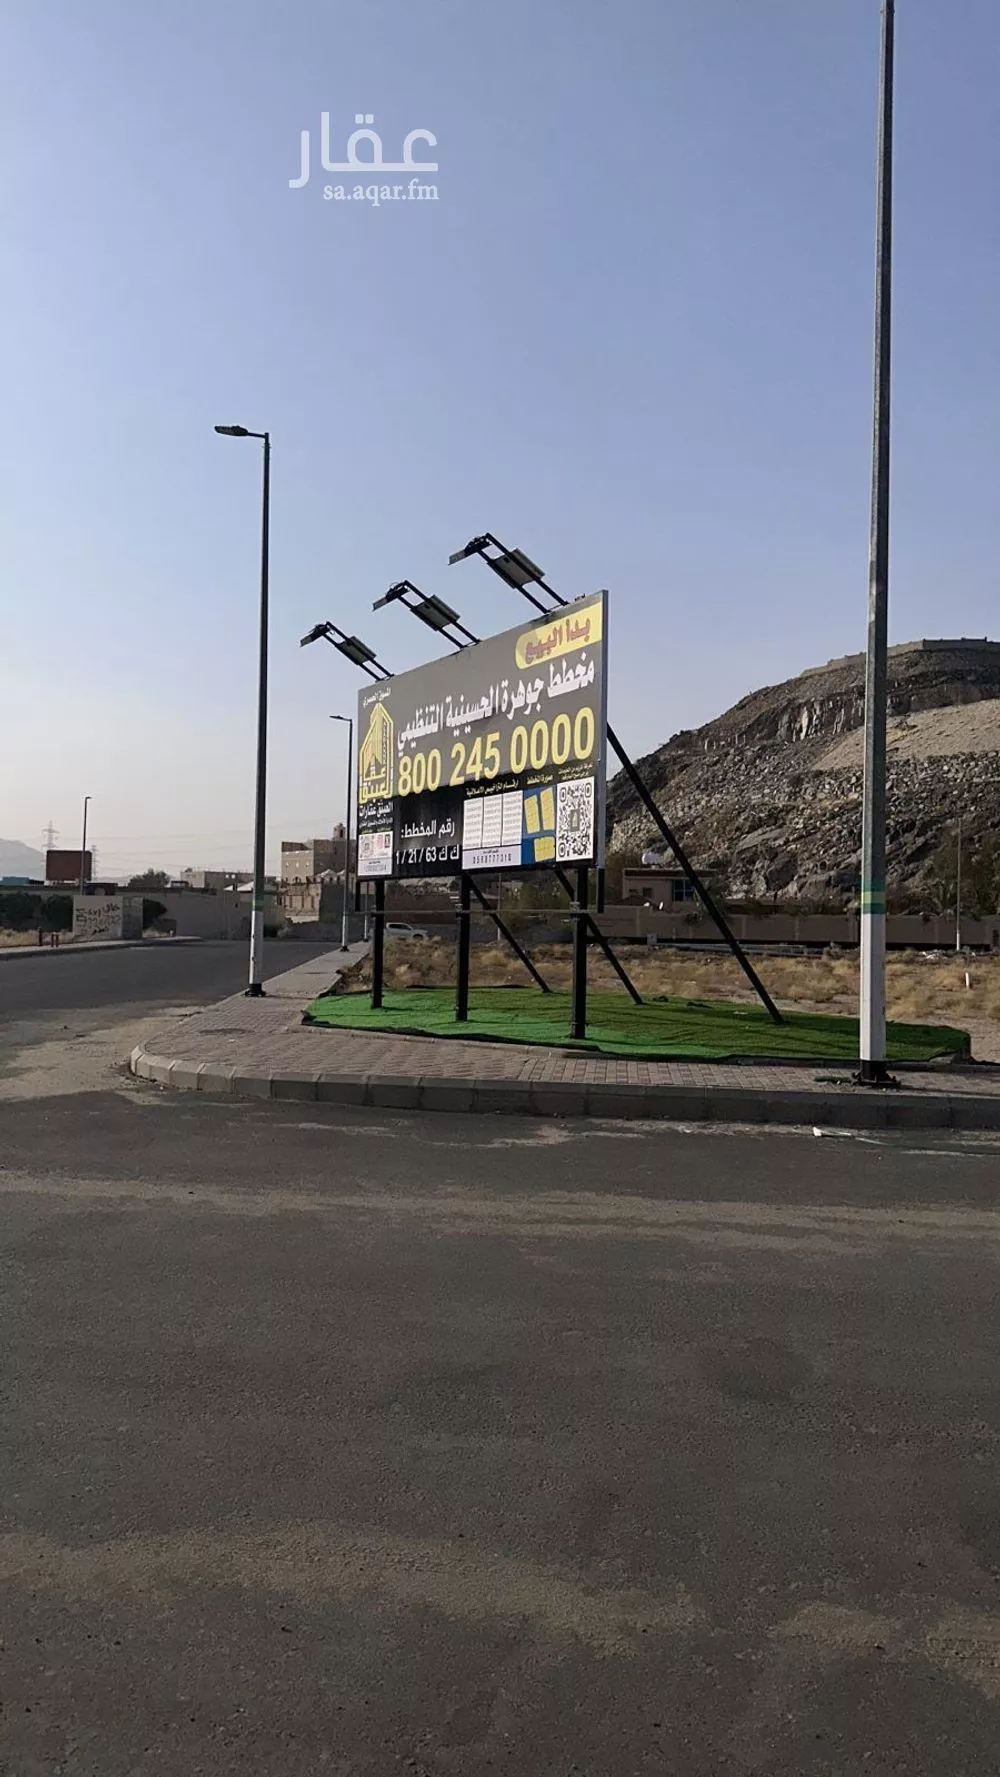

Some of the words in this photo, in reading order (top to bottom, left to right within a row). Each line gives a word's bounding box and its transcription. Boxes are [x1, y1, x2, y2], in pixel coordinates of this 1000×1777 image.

[525, 625, 563, 665] البيع
[547, 651, 595, 698] مخطط
[445, 683, 500, 737] الحسينية
[501, 677, 545, 720] جوهرة
[397, 701, 444, 757] التنظيمي
[398, 748, 442, 797] 800
[449, 731, 501, 787] 245
[510, 706, 595, 774] 0000
[401, 819, 437, 838] المخطط:
[438, 818, 455, 838] رقم
